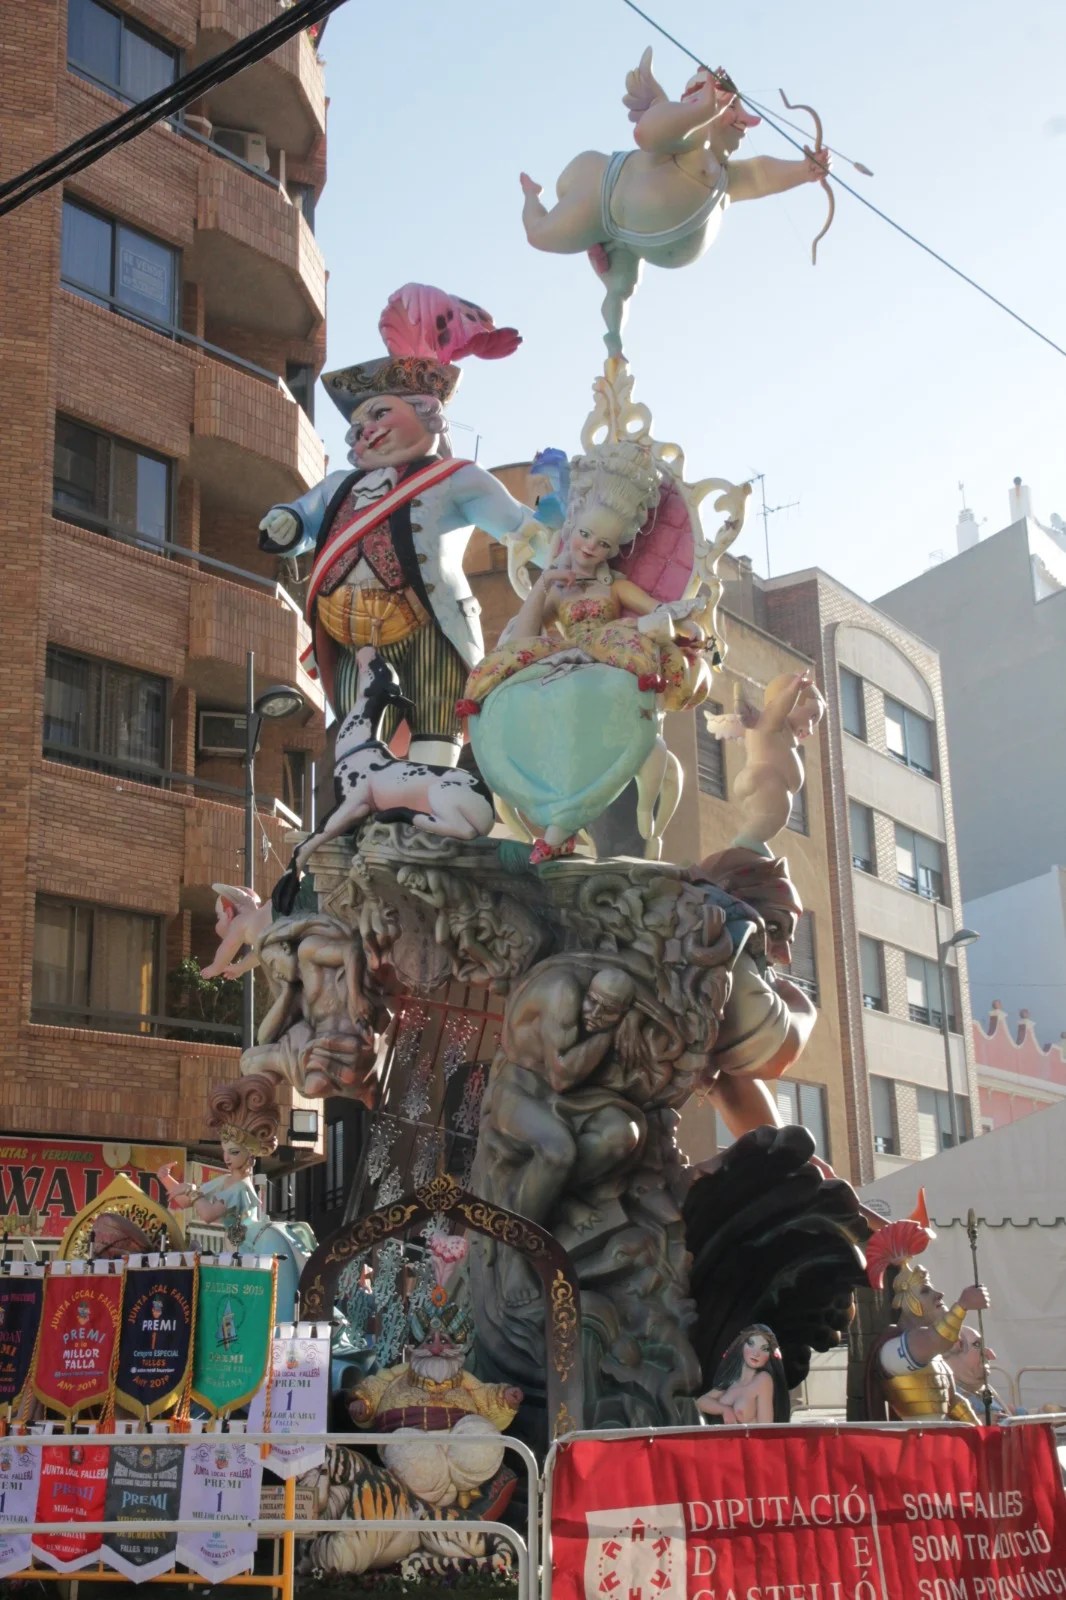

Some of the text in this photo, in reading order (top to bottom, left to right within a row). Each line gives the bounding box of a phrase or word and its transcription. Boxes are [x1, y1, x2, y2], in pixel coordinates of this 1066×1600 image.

[0, 1147, 28, 1159] UTAS
[41, 1149, 94, 1162] VERDURAS
[0, 1165, 169, 1217] WALD
[205, 1282, 264, 1295] FALLES 2019
[51, 1289, 120, 1329] JUNTA LOCAL FALLERA
[128, 1295, 148, 1324] JUNTA
[170, 1288, 190, 1324] FALLERA
[142, 1320, 177, 1331] PREMI
[63, 1328, 105, 1344] PREMI
[63, 1348, 99, 1359] MILLOR
[65, 1359, 95, 1369] FALLA
[299, 1368, 320, 1378] FALLERA
[76, 1378, 97, 1390] 2019
[275, 1380, 312, 1388] PREMI
[286, 1389, 293, 1411] 1
[12, 1471, 33, 1480] FALLERA
[42, 1464, 64, 1475] JUNTA
[80, 1468, 109, 1479] FALLERA
[194, 1464, 209, 1476] JUNTA
[230, 1468, 252, 1478] FALLERA
[204, 1479, 242, 1488] PREMI
[121, 1491, 168, 1510] PREMI
[217, 1491, 223, 1512] 1
[688, 1484, 866, 1532] DIPUTACIÓ
[903, 1490, 1023, 1520] SOM FALLES
[120, 1544, 140, 1553] FALLES
[912, 1523, 1051, 1562] SOM TRADICIÓ
[918, 1578, 967, 1600] SOM
